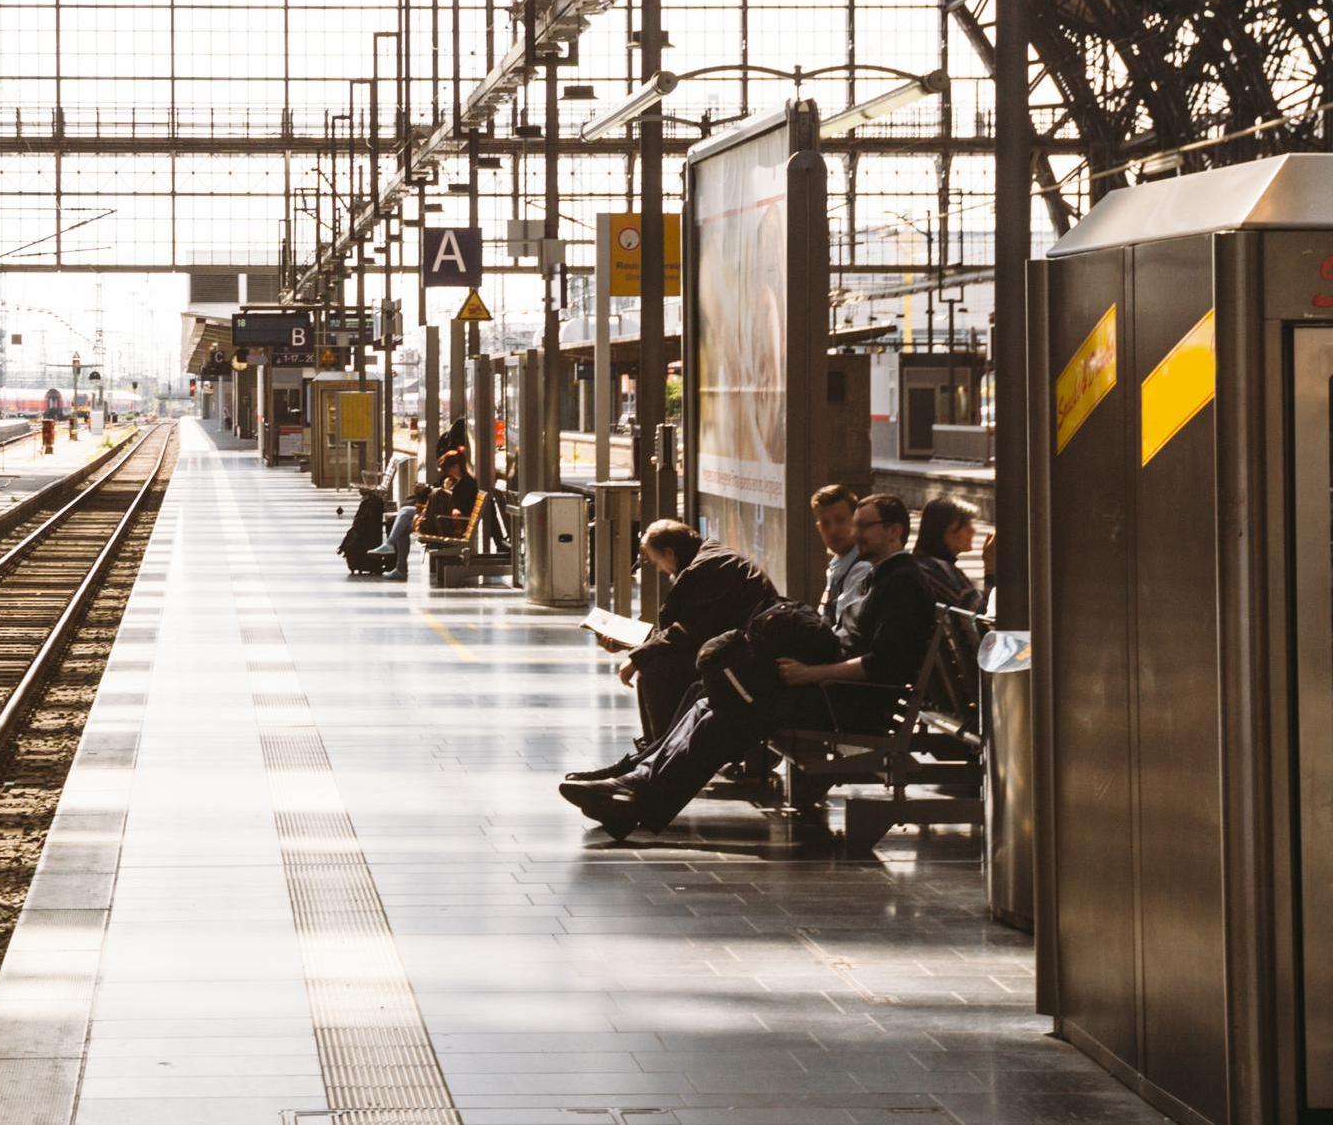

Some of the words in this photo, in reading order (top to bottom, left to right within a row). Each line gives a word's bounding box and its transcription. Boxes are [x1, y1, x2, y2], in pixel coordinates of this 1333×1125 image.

[431, 230, 467, 273] A
[292, 327, 306, 346] B
[214, 352, 224, 363] C
